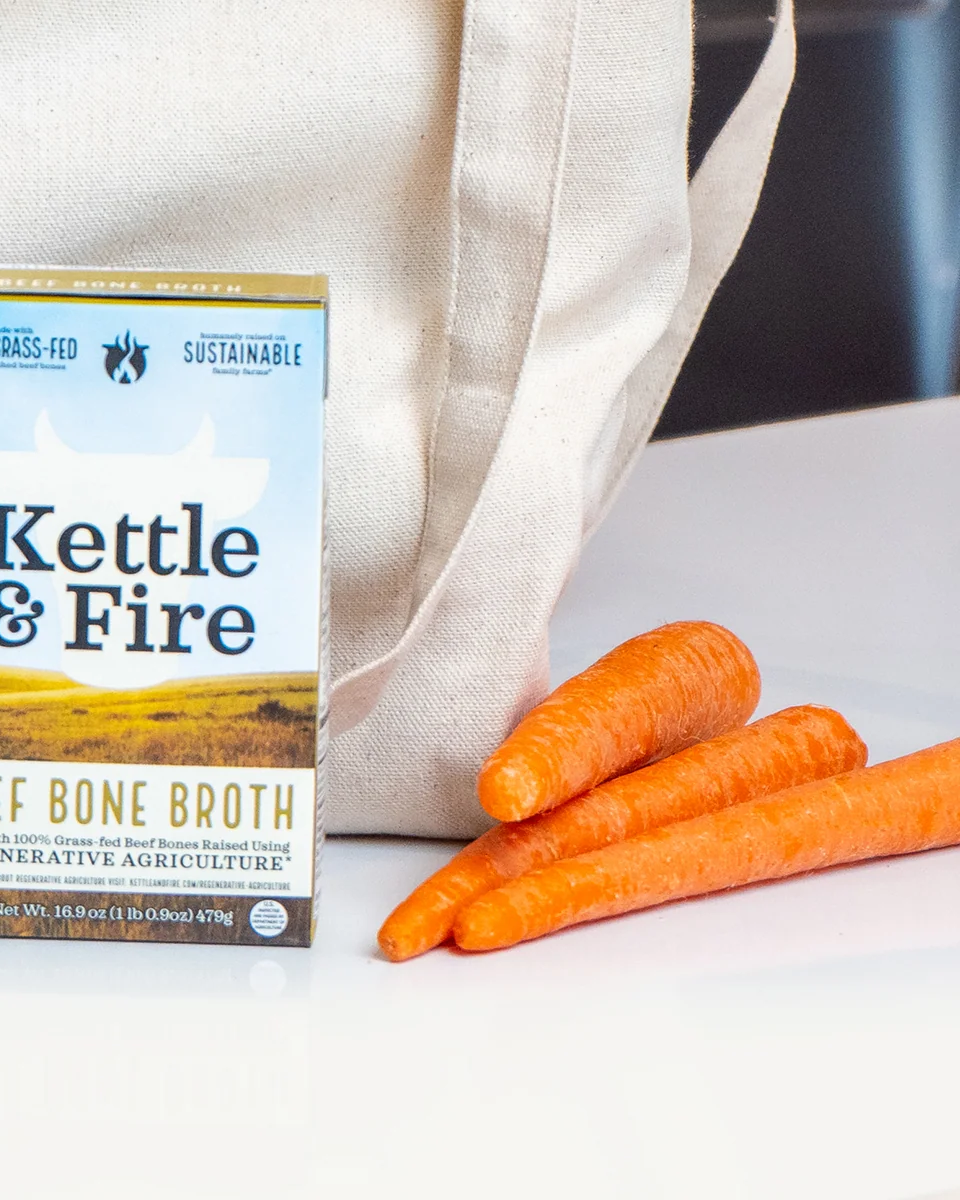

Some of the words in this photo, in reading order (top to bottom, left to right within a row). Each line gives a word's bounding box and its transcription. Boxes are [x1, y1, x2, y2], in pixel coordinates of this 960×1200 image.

[73, 280, 142, 290] BONE
[155, 282, 242, 293] BROTH
[183, 341, 303, 366] SUSTAINABLE
[64, 582, 256, 656] Fire
[49, 777, 148, 827] BONE
[169, 781, 293, 831] BROTH
[14, 833, 51, 845] 100%
[54, 834, 121, 848] Grass-fed
[124, 837, 156, 848] Beef
[158, 838, 199, 850] Bones
[202, 839, 248, 851] Raised
[251, 840, 291, 854] Using
[22, 903, 50, 918] Wt.
[54, 905, 86, 919] 16.9
[88, 909, 107, 919] oz
[109, 905, 123, 921] (1
[126, 907, 143, 920] lb
[145, 908, 193, 923] 0.9oz)
[195, 909, 234, 926] 479g
